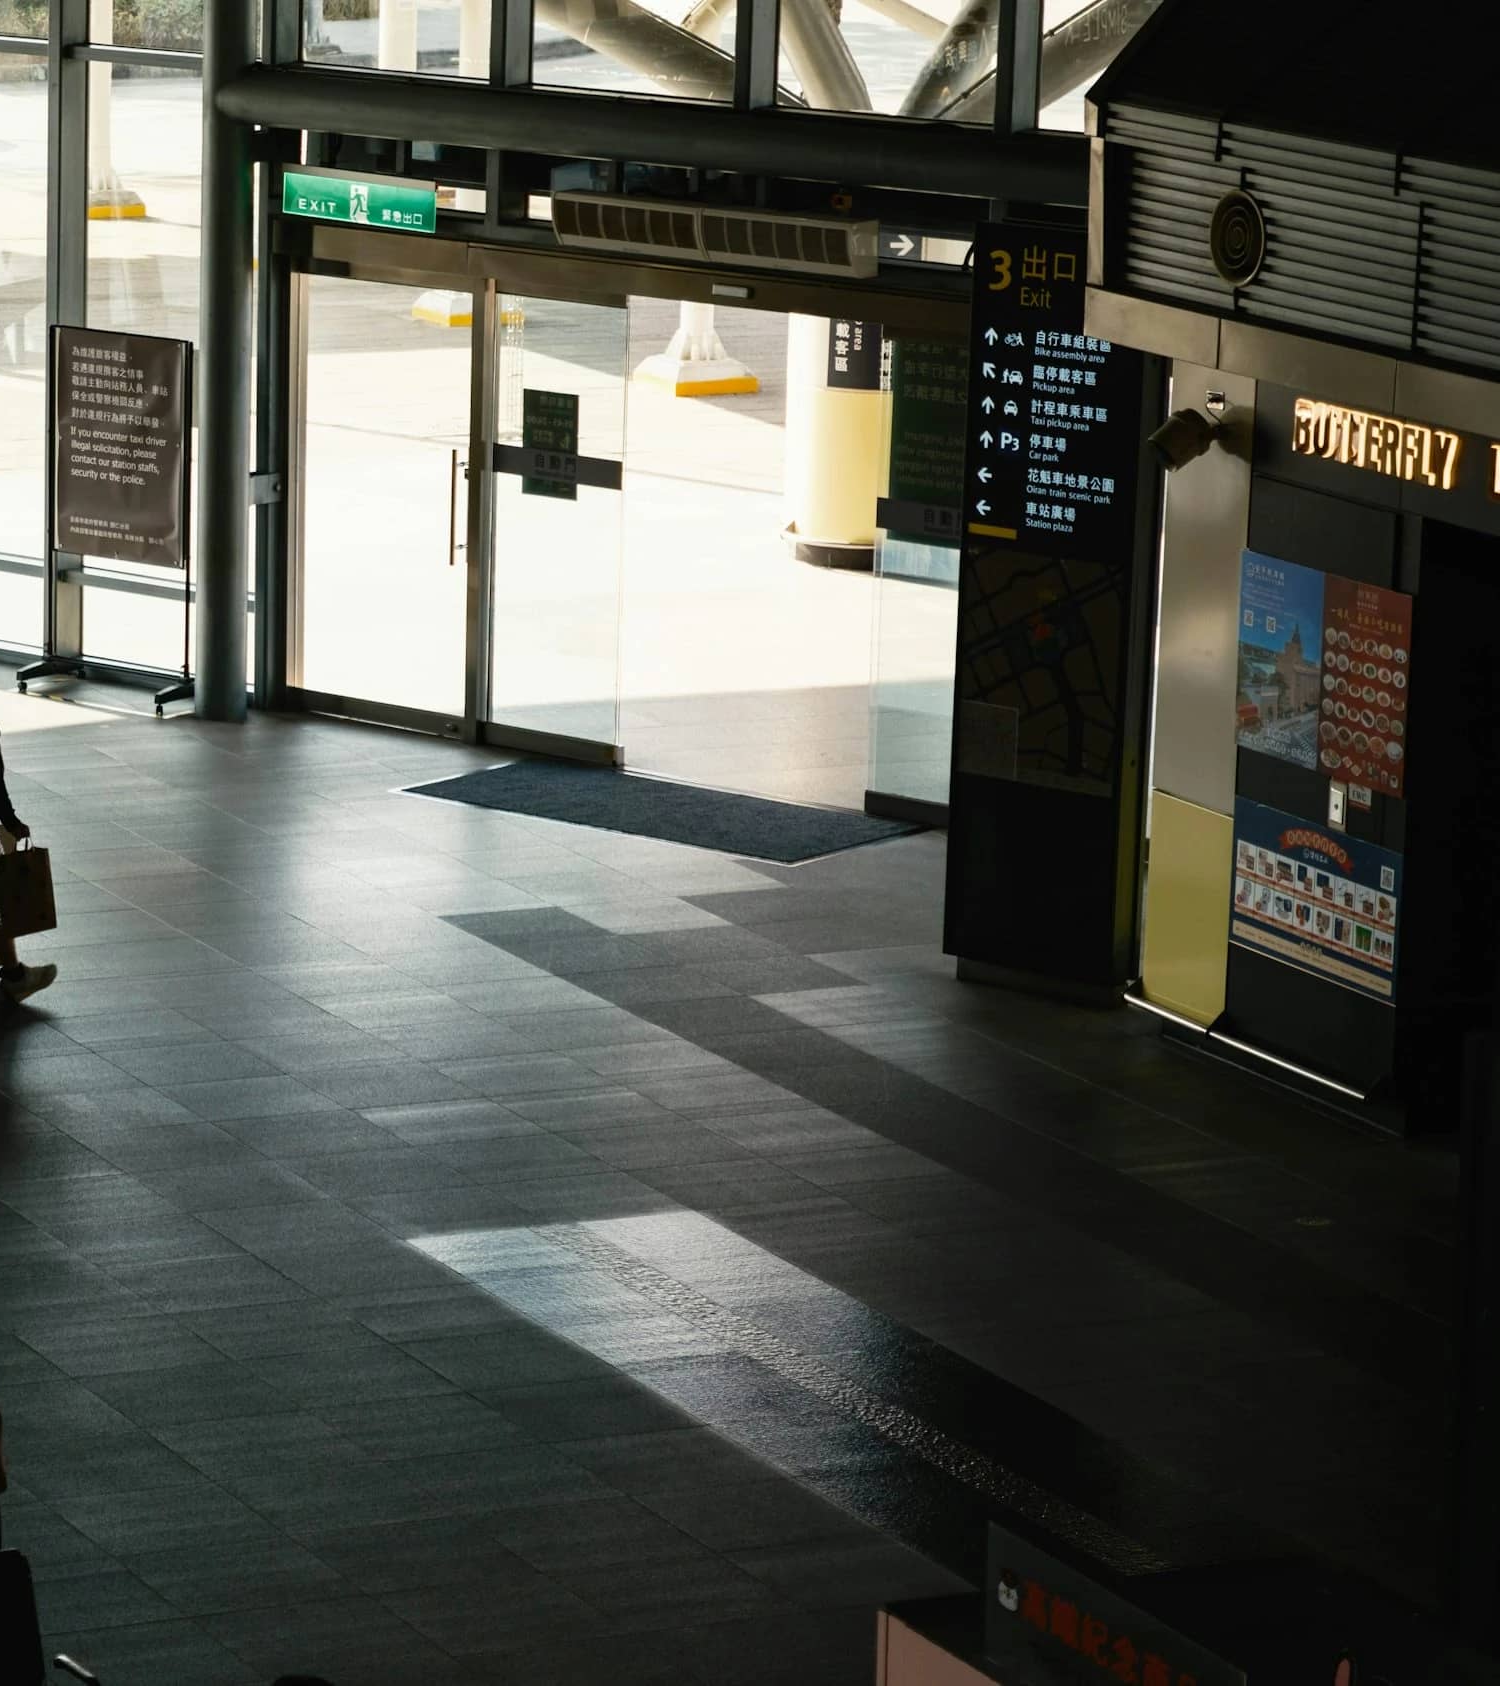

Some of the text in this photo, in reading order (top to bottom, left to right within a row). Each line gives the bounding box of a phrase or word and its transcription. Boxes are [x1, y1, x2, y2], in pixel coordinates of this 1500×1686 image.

[298, 198, 336, 213] EXIT
[382, 209, 423, 225] 緊急出口
[988, 250, 1012, 290] 3
[1021, 245, 1077, 282] 出口
[1020, 287, 1052, 310] Exit
[1035, 330, 1111, 354] 自行車組裝區
[1035, 347, 1105, 364] Bike assembly area
[1033, 364, 1097, 386] 臨停載客區
[1032, 382, 1075, 395] Pickup area
[1030, 399, 1108, 422] 計程車乘車區
[1031, 416, 1089, 432] Taxi pickup area
[78, 430, 91, 439] you
[92, 430, 128, 442] encounter
[130, 434, 143, 444] taxi
[145, 436, 167, 447] driver
[1029, 433, 1066, 453] 停車場
[1293, 398, 1459, 490] BUTTERFLY
[92, 443, 132, 457] solicitation,
[133, 448, 157, 460] please
[1028, 450, 1059, 462] Car park
[71, 454, 160, 475] contact our station staffs,
[71, 468, 146, 485] security or the police.
[1027, 467, 1115, 493] 花魁車地景公園
[1026, 485, 1111, 504] Oiran train scenic park
[1025, 501, 1076, 522] 車站廣場
[1025, 518, 1073, 533] Station plaza
[1021, 1578, 1197, 1686] 高鐵紀念商
